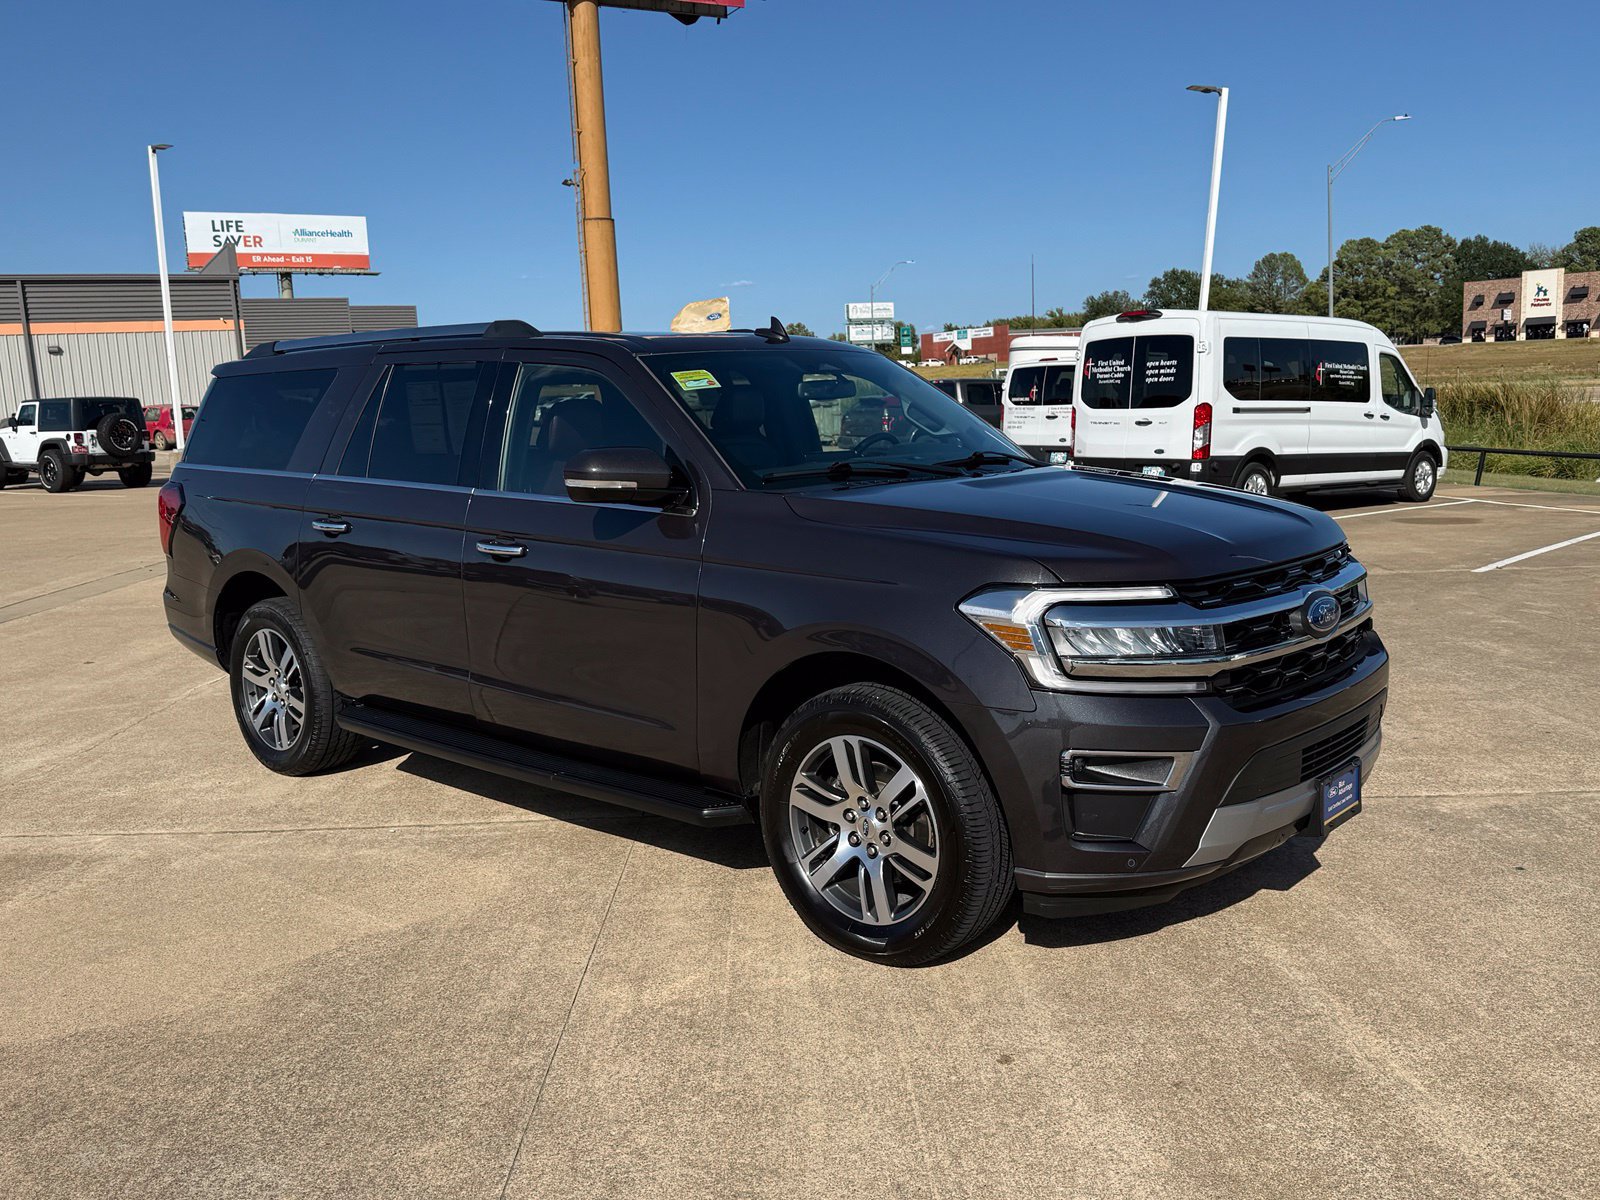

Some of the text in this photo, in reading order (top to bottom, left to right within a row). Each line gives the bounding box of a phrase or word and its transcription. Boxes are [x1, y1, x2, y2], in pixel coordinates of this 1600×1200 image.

[211, 220, 244, 232] LIFE
[294, 228, 353, 238] AllianceHealth
[212, 235, 263, 248] SAVER
